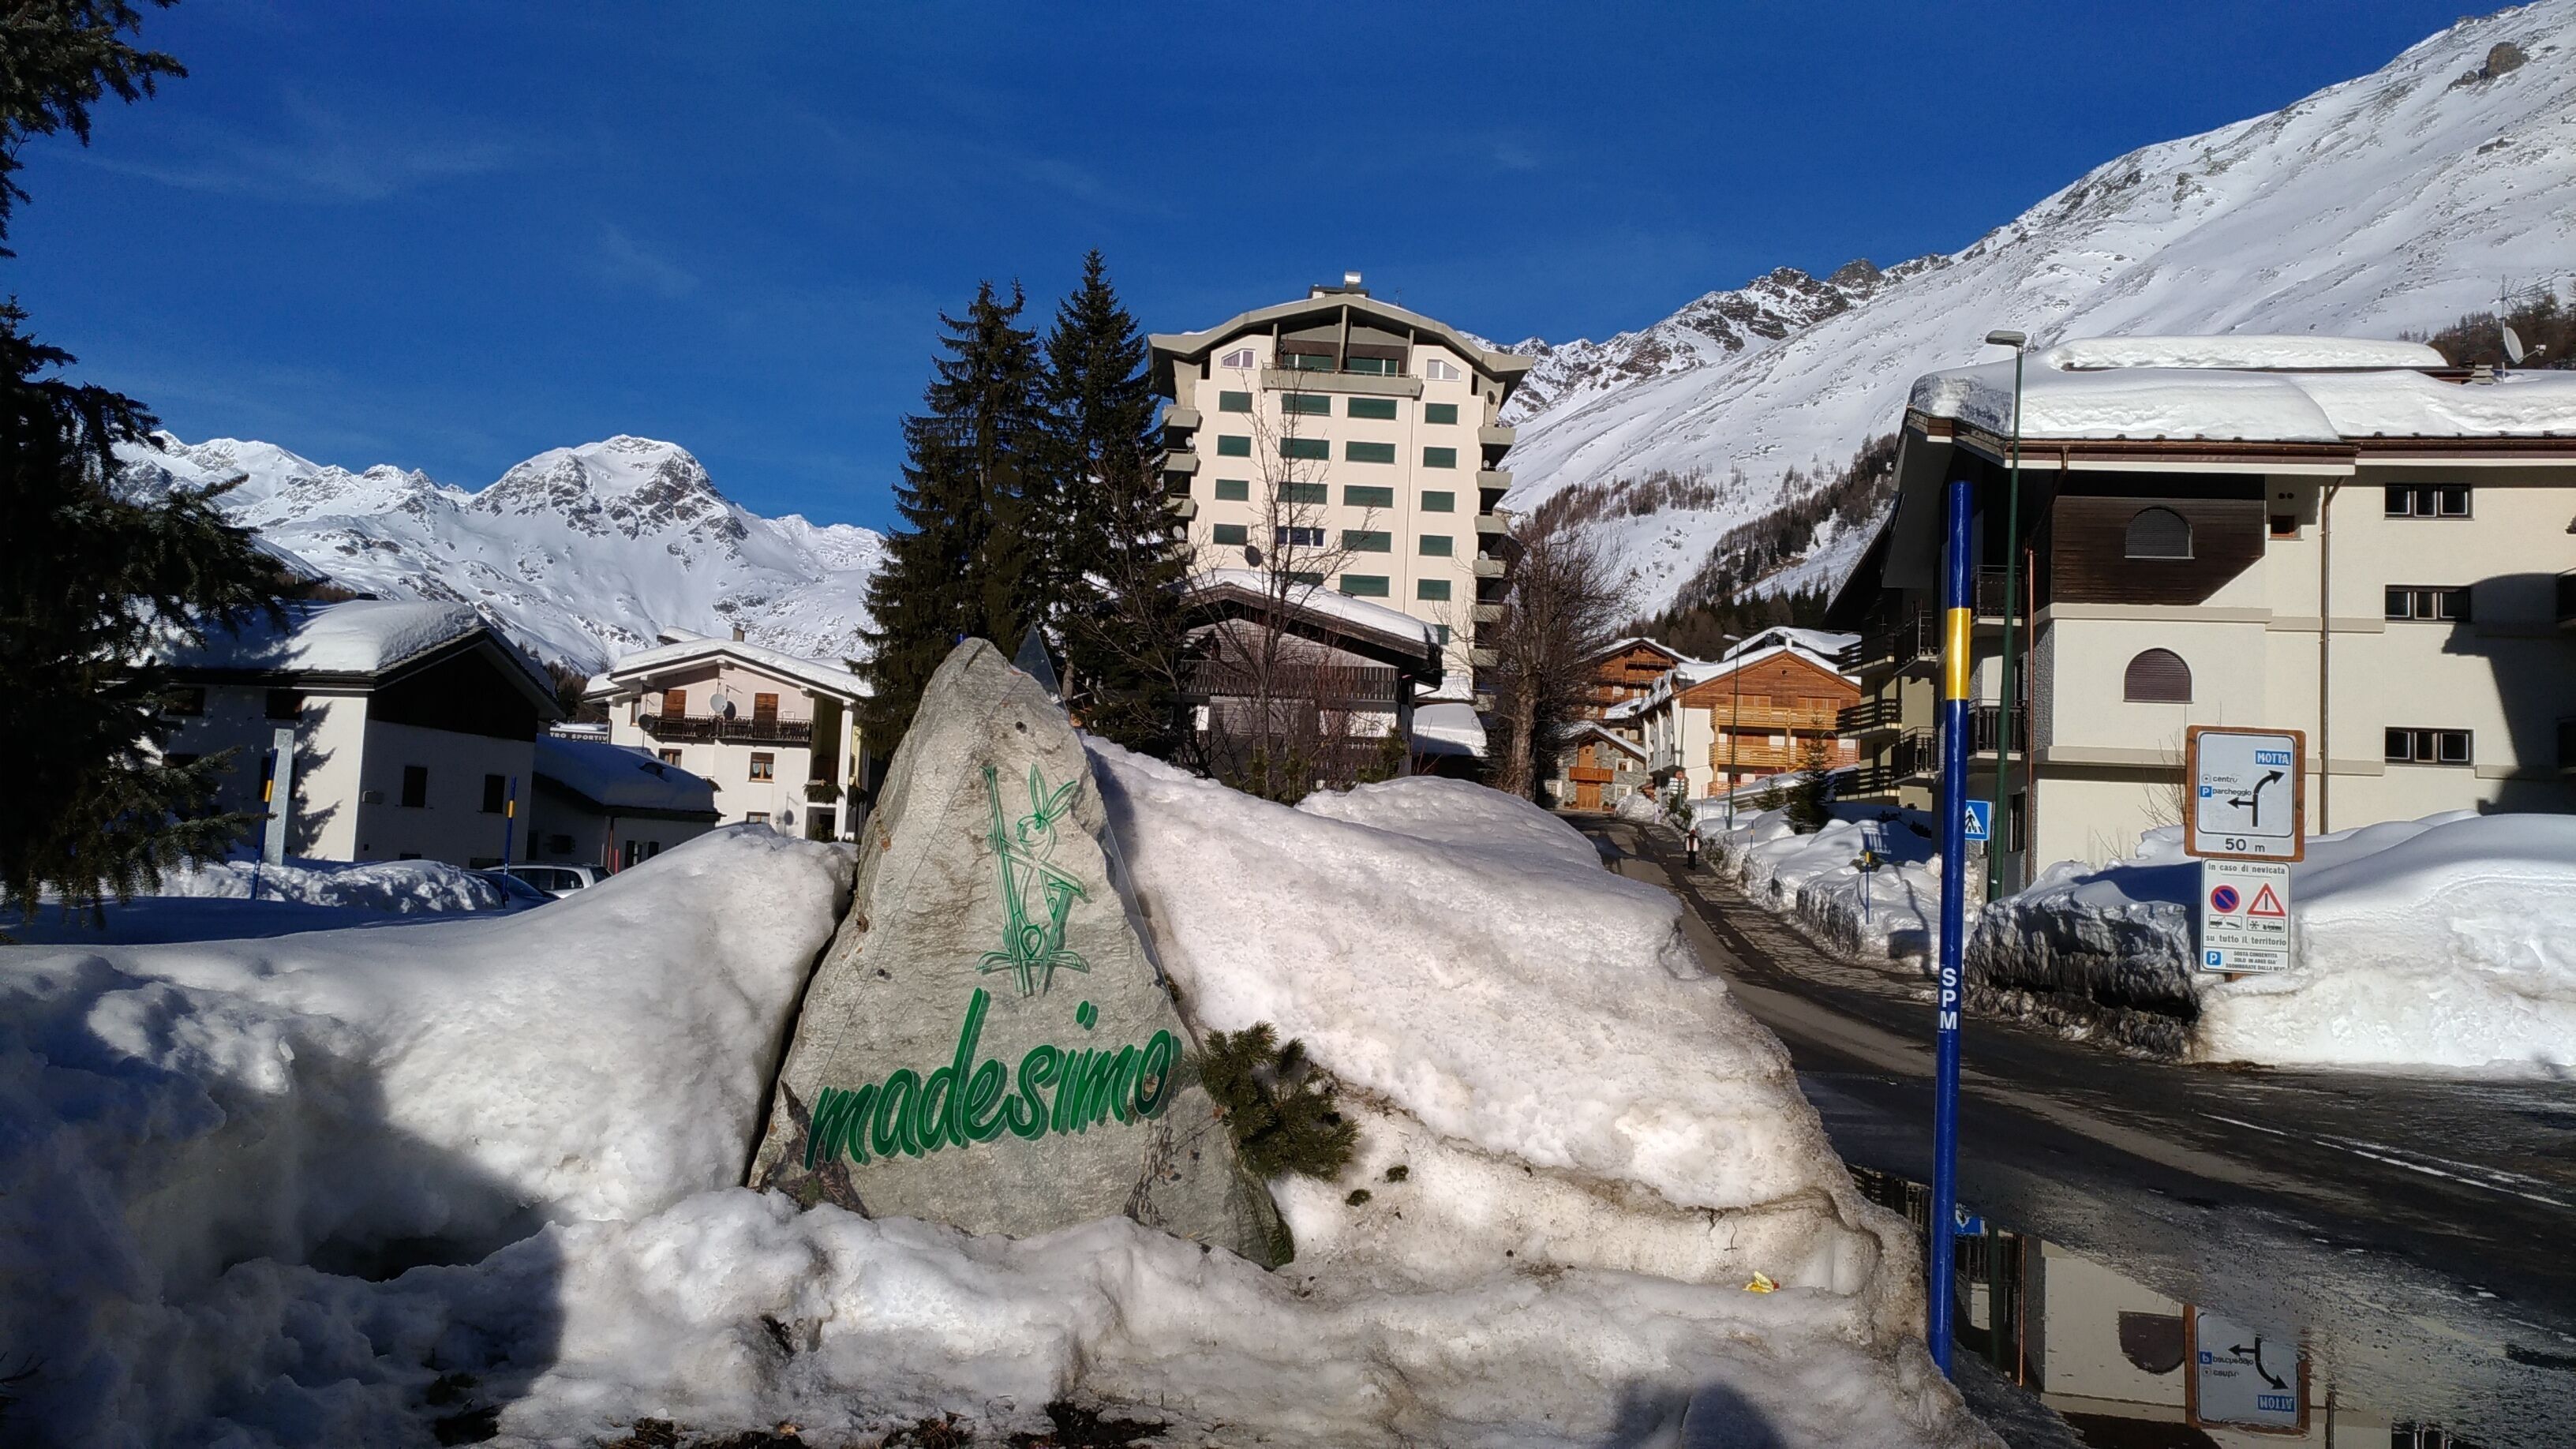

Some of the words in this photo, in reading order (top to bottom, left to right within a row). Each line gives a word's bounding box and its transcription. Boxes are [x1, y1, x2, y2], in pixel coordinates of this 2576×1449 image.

[2256, 752, 2289, 764] MOTTA
[2202, 787, 2210, 796] P
[2225, 838, 2246, 851] 50
[2219, 934, 2239, 943] tutto
[2251, 937, 2286, 946] territorio
[2209, 953, 2218, 964] P
[1940, 968, 1957, 1030] SPM
[803, 987, 1178, 1171] madesimo
